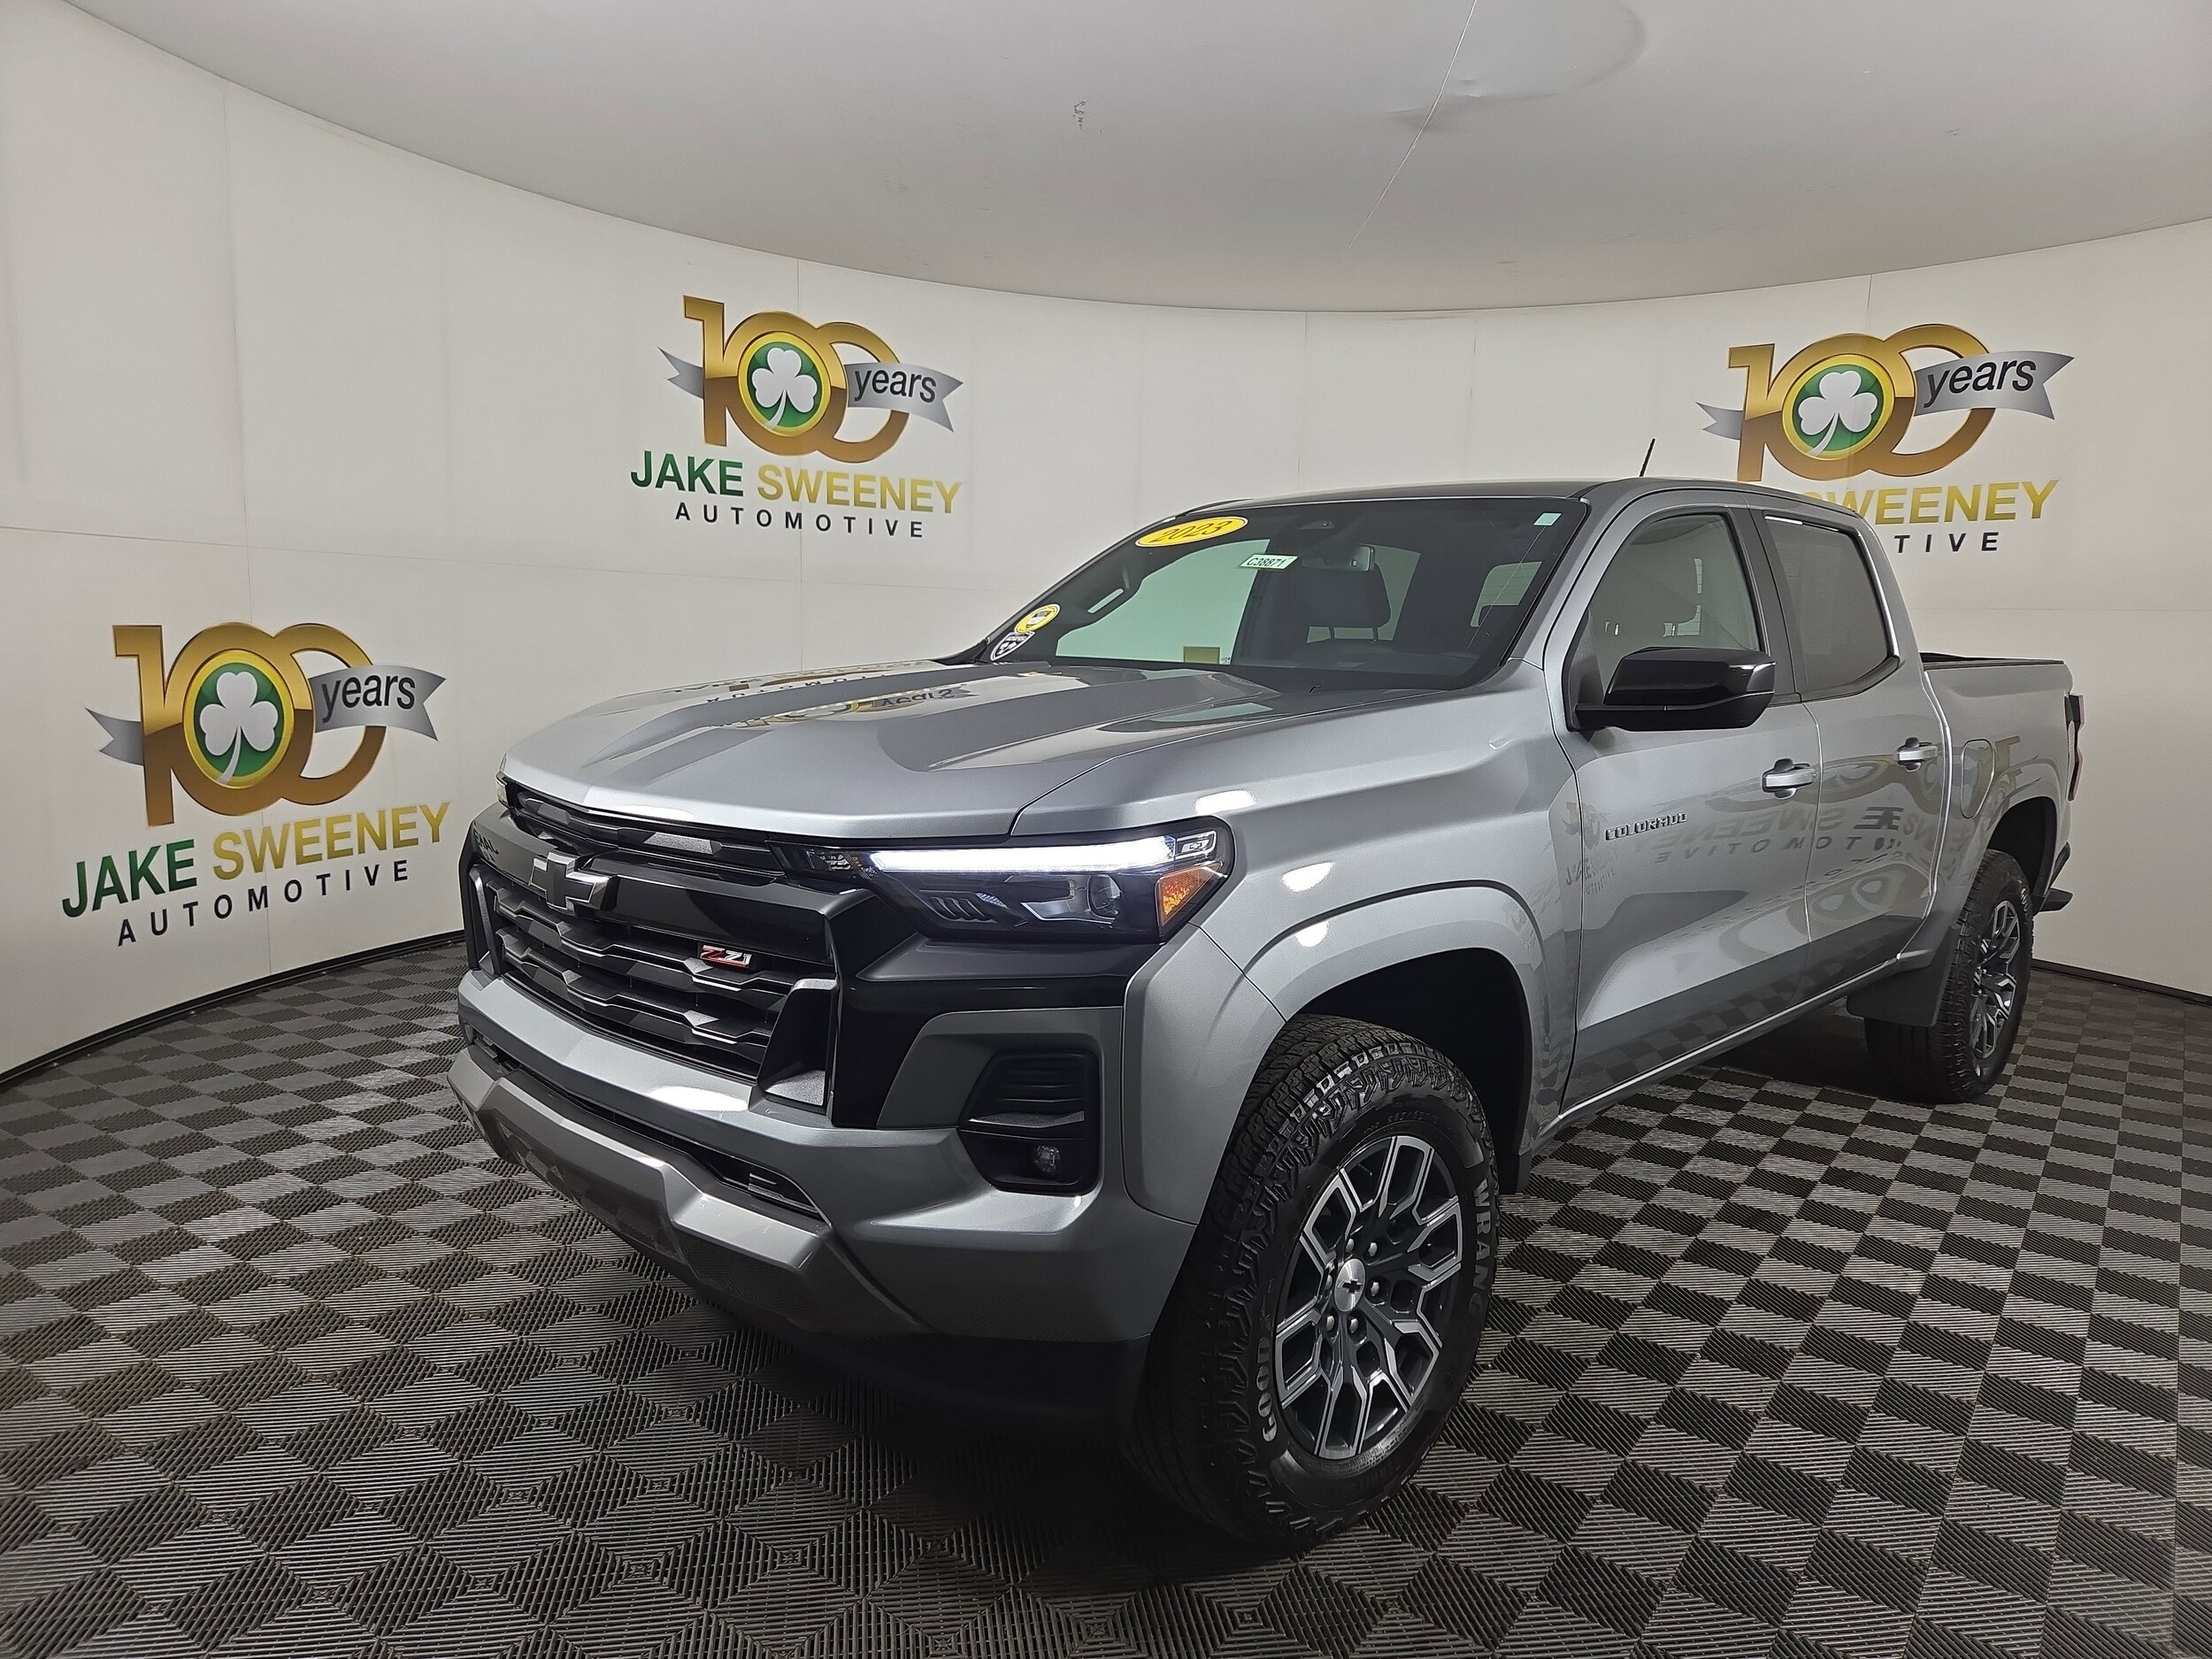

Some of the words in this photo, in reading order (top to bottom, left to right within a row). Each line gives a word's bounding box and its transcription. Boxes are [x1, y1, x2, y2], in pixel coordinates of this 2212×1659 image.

[854, 368, 937, 403] years
[1923, 357, 2037, 408] years
[630, 449, 745, 497] JAKE
[757, 464, 962, 514] SWEENEY
[674, 502, 924, 538] AUTOMOTIVE
[1148, 520, 1233, 543] 2023
[1246, 557, 1286, 568] C38871
[321, 674, 417, 723] years
[1605, 812, 1687, 841] COLORADO
[61, 839, 198, 918] JAKE
[212, 801, 450, 881] SWEENEY
[118, 860, 409, 947] AUTOMOTIVE
